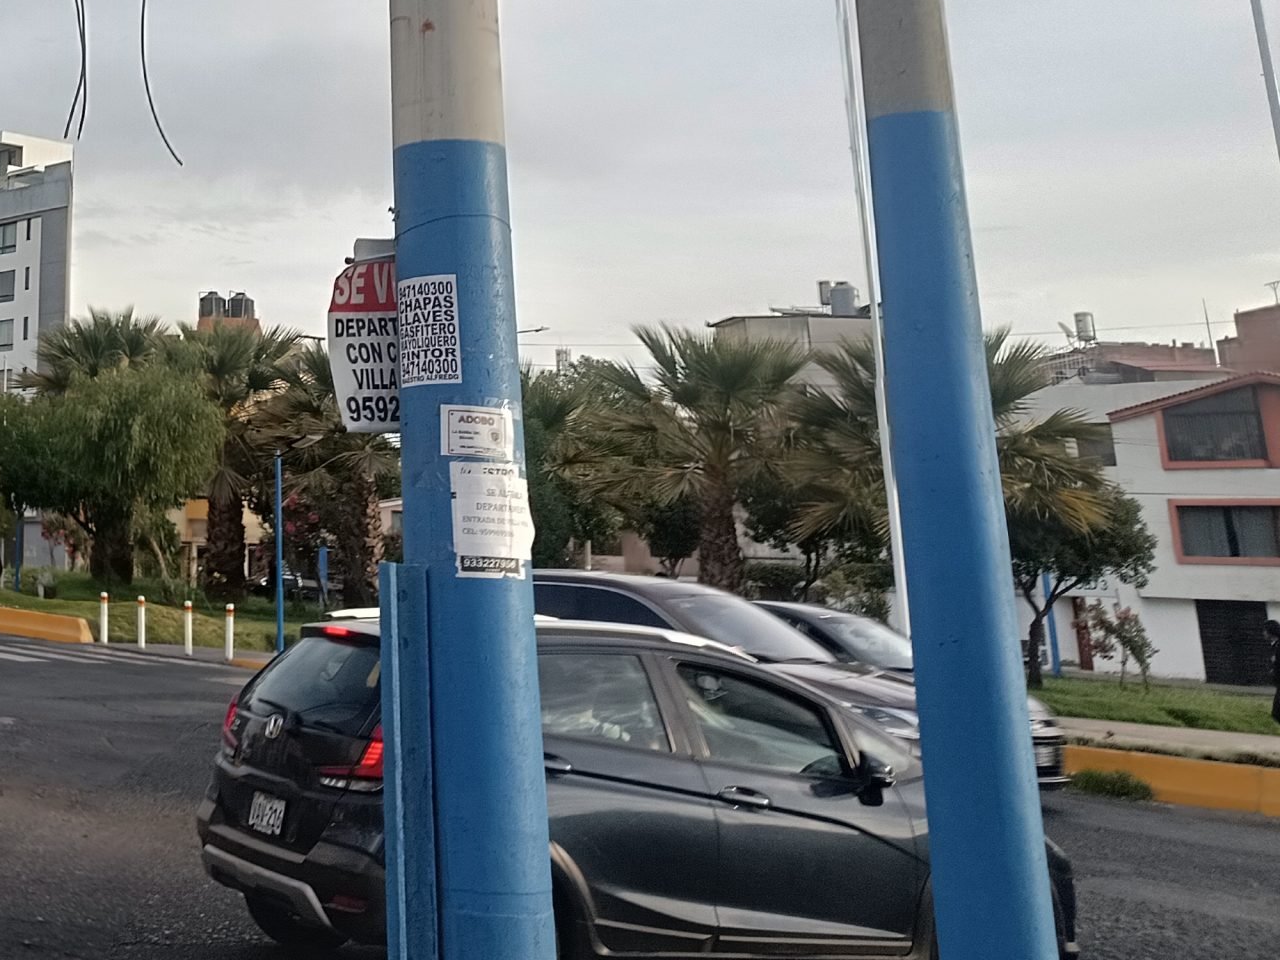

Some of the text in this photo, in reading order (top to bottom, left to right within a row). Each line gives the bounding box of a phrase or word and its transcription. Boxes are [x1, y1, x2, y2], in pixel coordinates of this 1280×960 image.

[334, 264, 368, 306] SE
[399, 295, 454, 315] CHAPAS
[400, 309, 455, 328] LLAVES
[346, 342, 384, 365] CON
[401, 347, 457, 363] PINTOR
[352, 368, 398, 390] VILLA
[346, 395, 401, 423] 9592
[458, 415, 495, 427] ADOBO
